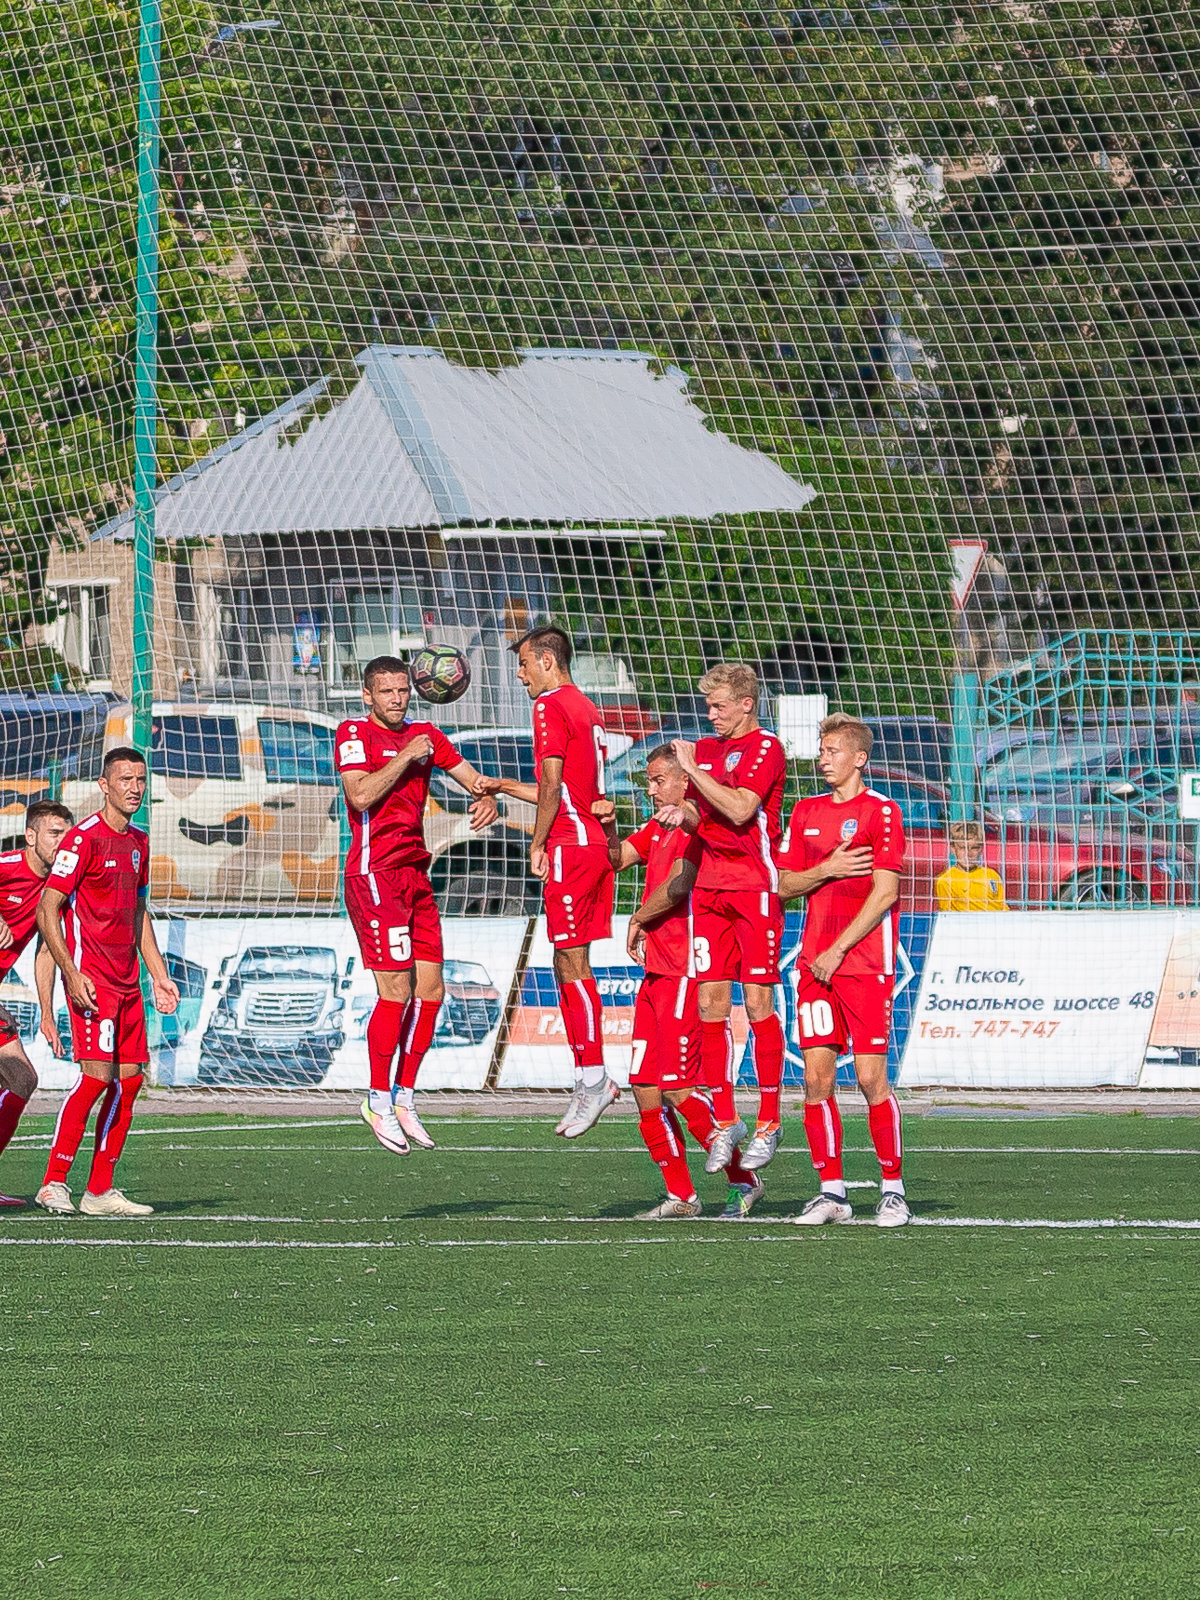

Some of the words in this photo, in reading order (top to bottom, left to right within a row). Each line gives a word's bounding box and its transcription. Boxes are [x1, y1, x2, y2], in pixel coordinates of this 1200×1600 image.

[388, 925, 412, 962] 5
[694, 936, 712, 973] 3
[931, 970, 945, 984] г.
[955, 966, 1025, 986] Псков,
[799, 999, 835, 1038] 10
[924, 993, 1044, 1012] Зональное
[1053, 996, 1120, 1012] шоссе
[1128, 991, 1156, 1009] 48
[98, 1018, 116, 1053] 8
[538, 1014, 567, 1035] ГА
[919, 1021, 961, 1039] Тел.
[971, 1020, 1061, 1039] 747-747
[629, 1039, 648, 1075] 7
